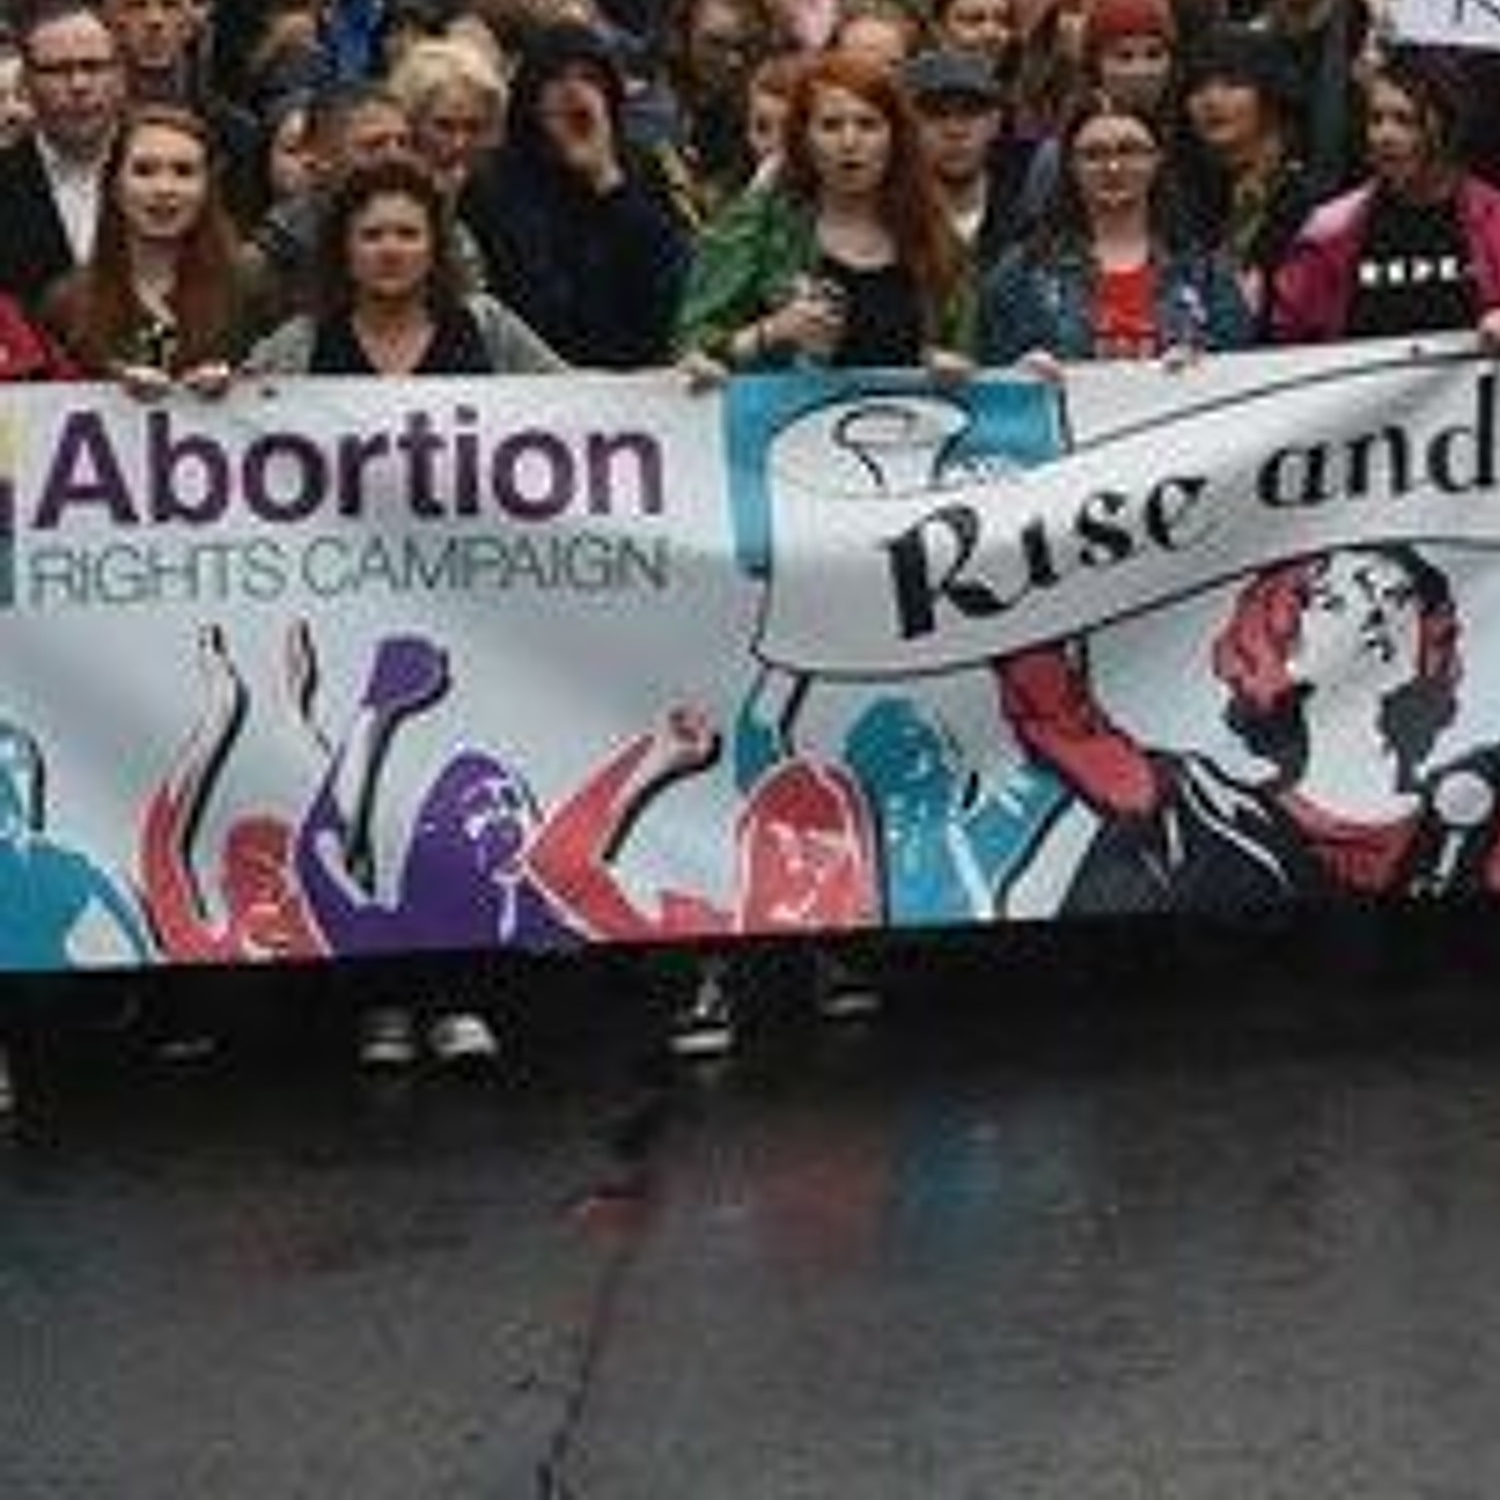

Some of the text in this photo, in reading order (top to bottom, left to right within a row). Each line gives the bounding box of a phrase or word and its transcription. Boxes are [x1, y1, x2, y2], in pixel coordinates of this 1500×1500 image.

[30, 406, 666, 530] Abortion
[888, 476, 1206, 638] Rise
[1256, 374, 1500, 508] and
[30, 530, 670, 605] RIGHTS CAMPAIGN
